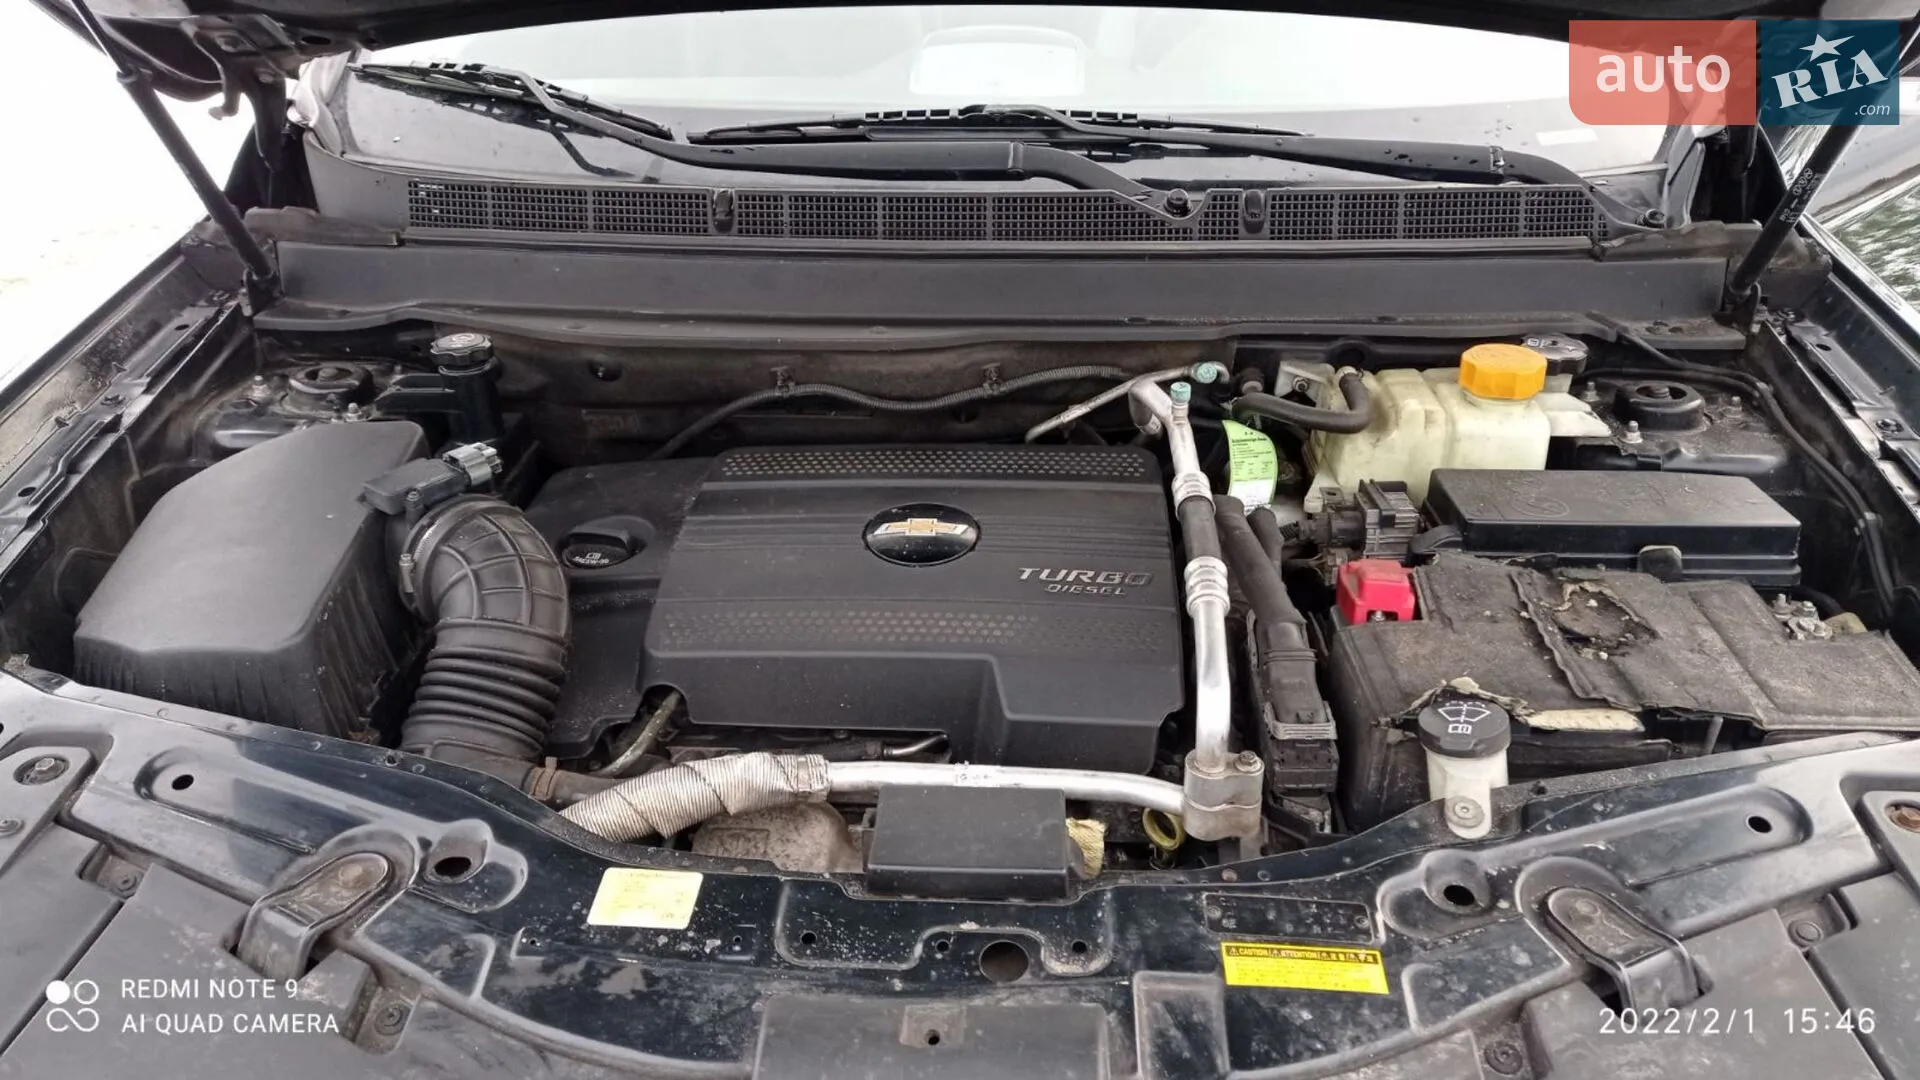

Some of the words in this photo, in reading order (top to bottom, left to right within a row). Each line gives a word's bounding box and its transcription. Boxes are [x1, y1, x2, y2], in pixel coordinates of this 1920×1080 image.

[1018, 567, 1152, 585] TURBO
[1045, 583, 1126, 595] DIESEL
[1238, 948, 1269, 957] CAUTION
